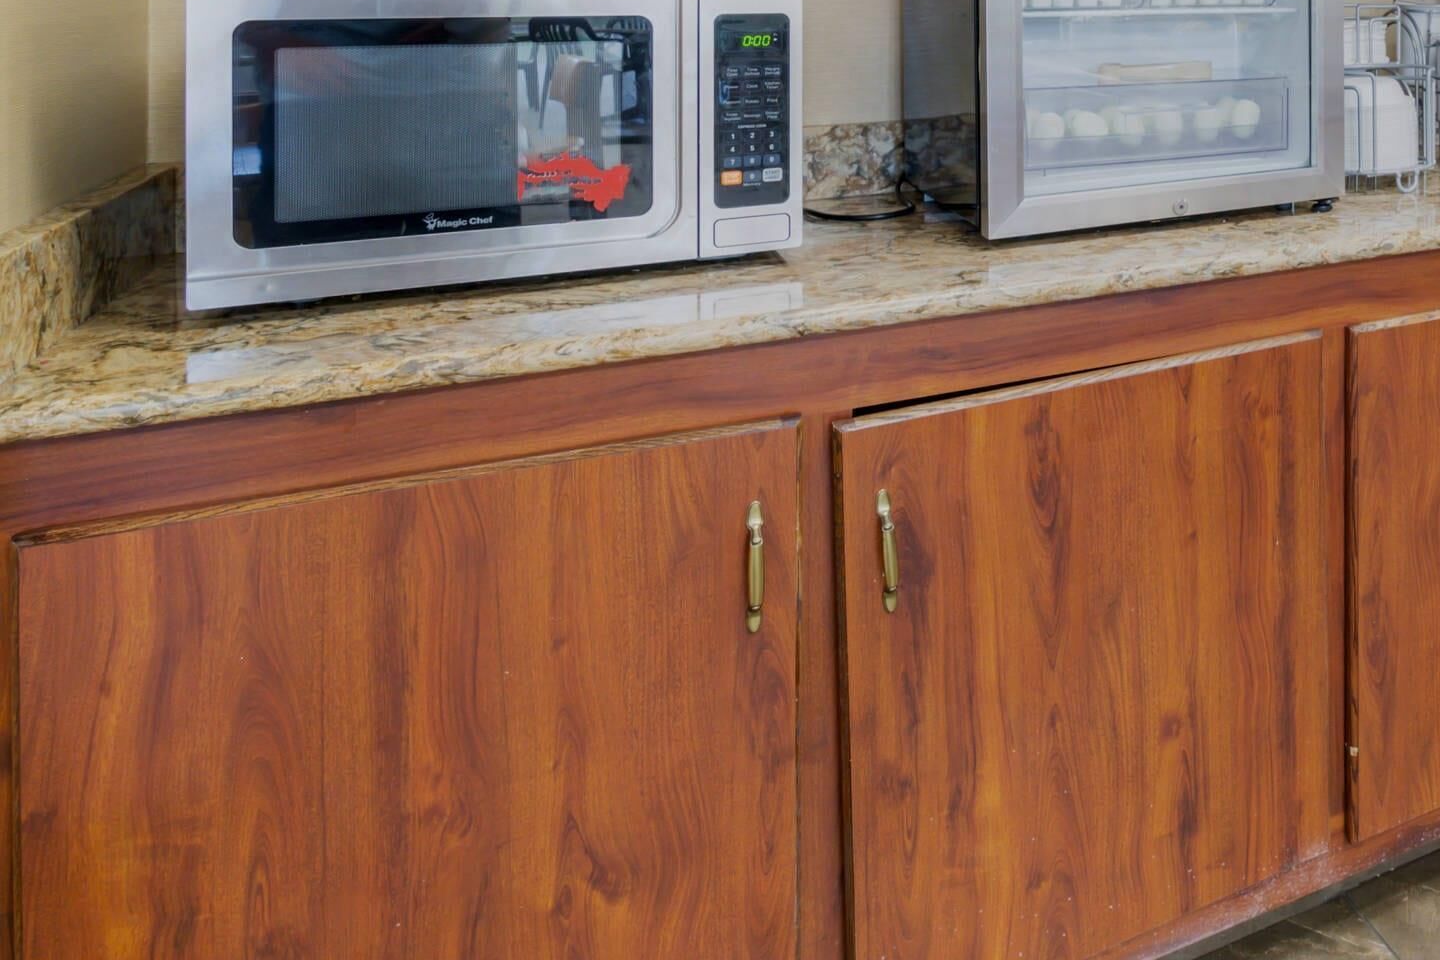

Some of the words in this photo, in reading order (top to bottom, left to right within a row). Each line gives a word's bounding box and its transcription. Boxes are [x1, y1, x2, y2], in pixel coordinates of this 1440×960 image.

[742, 35, 771, 47] 0:00
[437, 219, 468, 228] Magic
[469, 216, 493, 226] Chef
